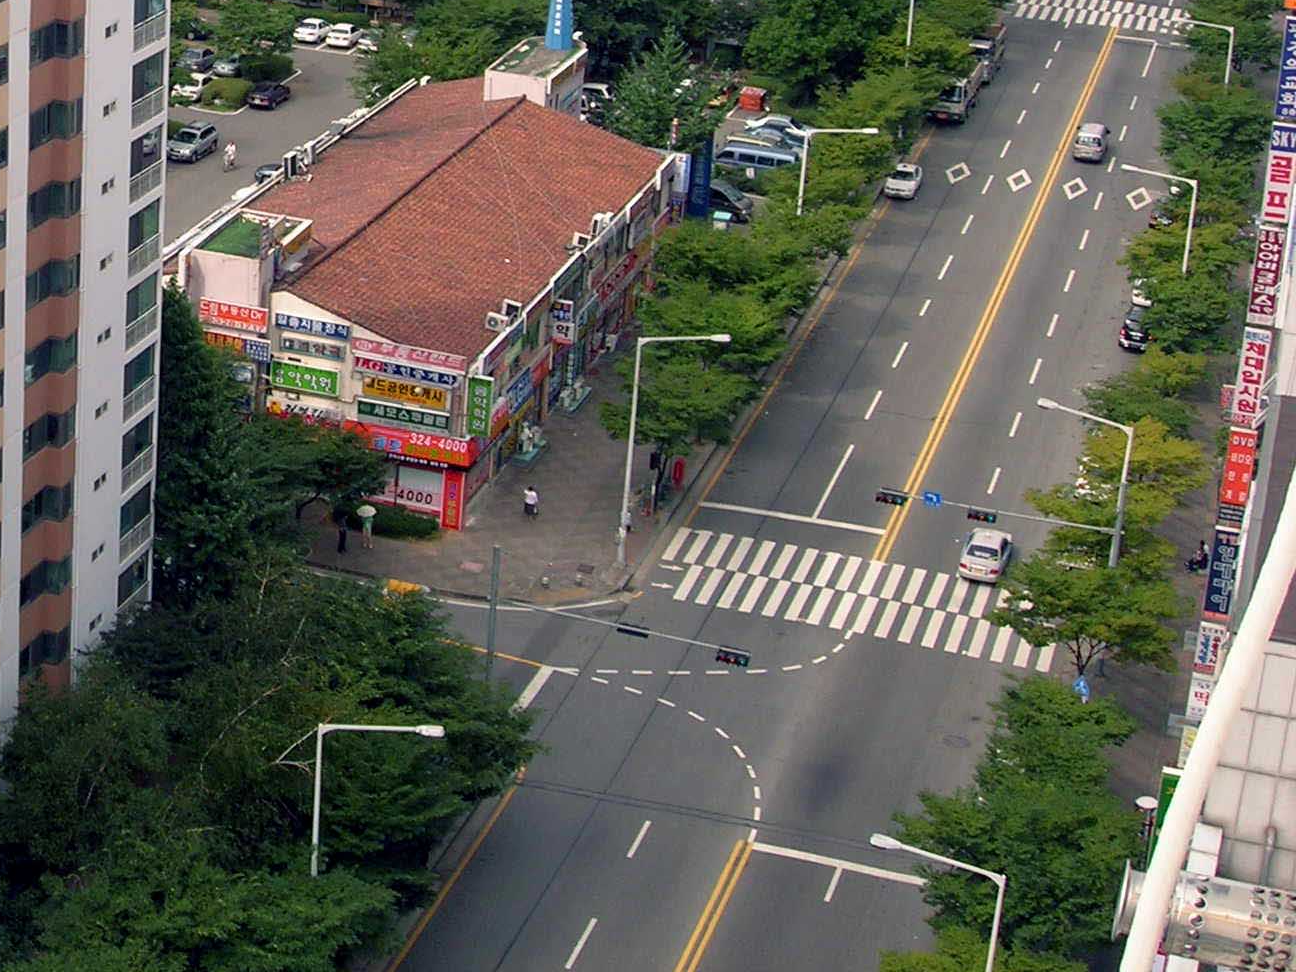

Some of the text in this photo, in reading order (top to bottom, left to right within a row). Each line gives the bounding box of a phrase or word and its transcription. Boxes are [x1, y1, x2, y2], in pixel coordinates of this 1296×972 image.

[1272, 129, 1296, 149] SKY
[357, 357, 382, 372] LG
[408, 432, 468, 453] 324-4000
